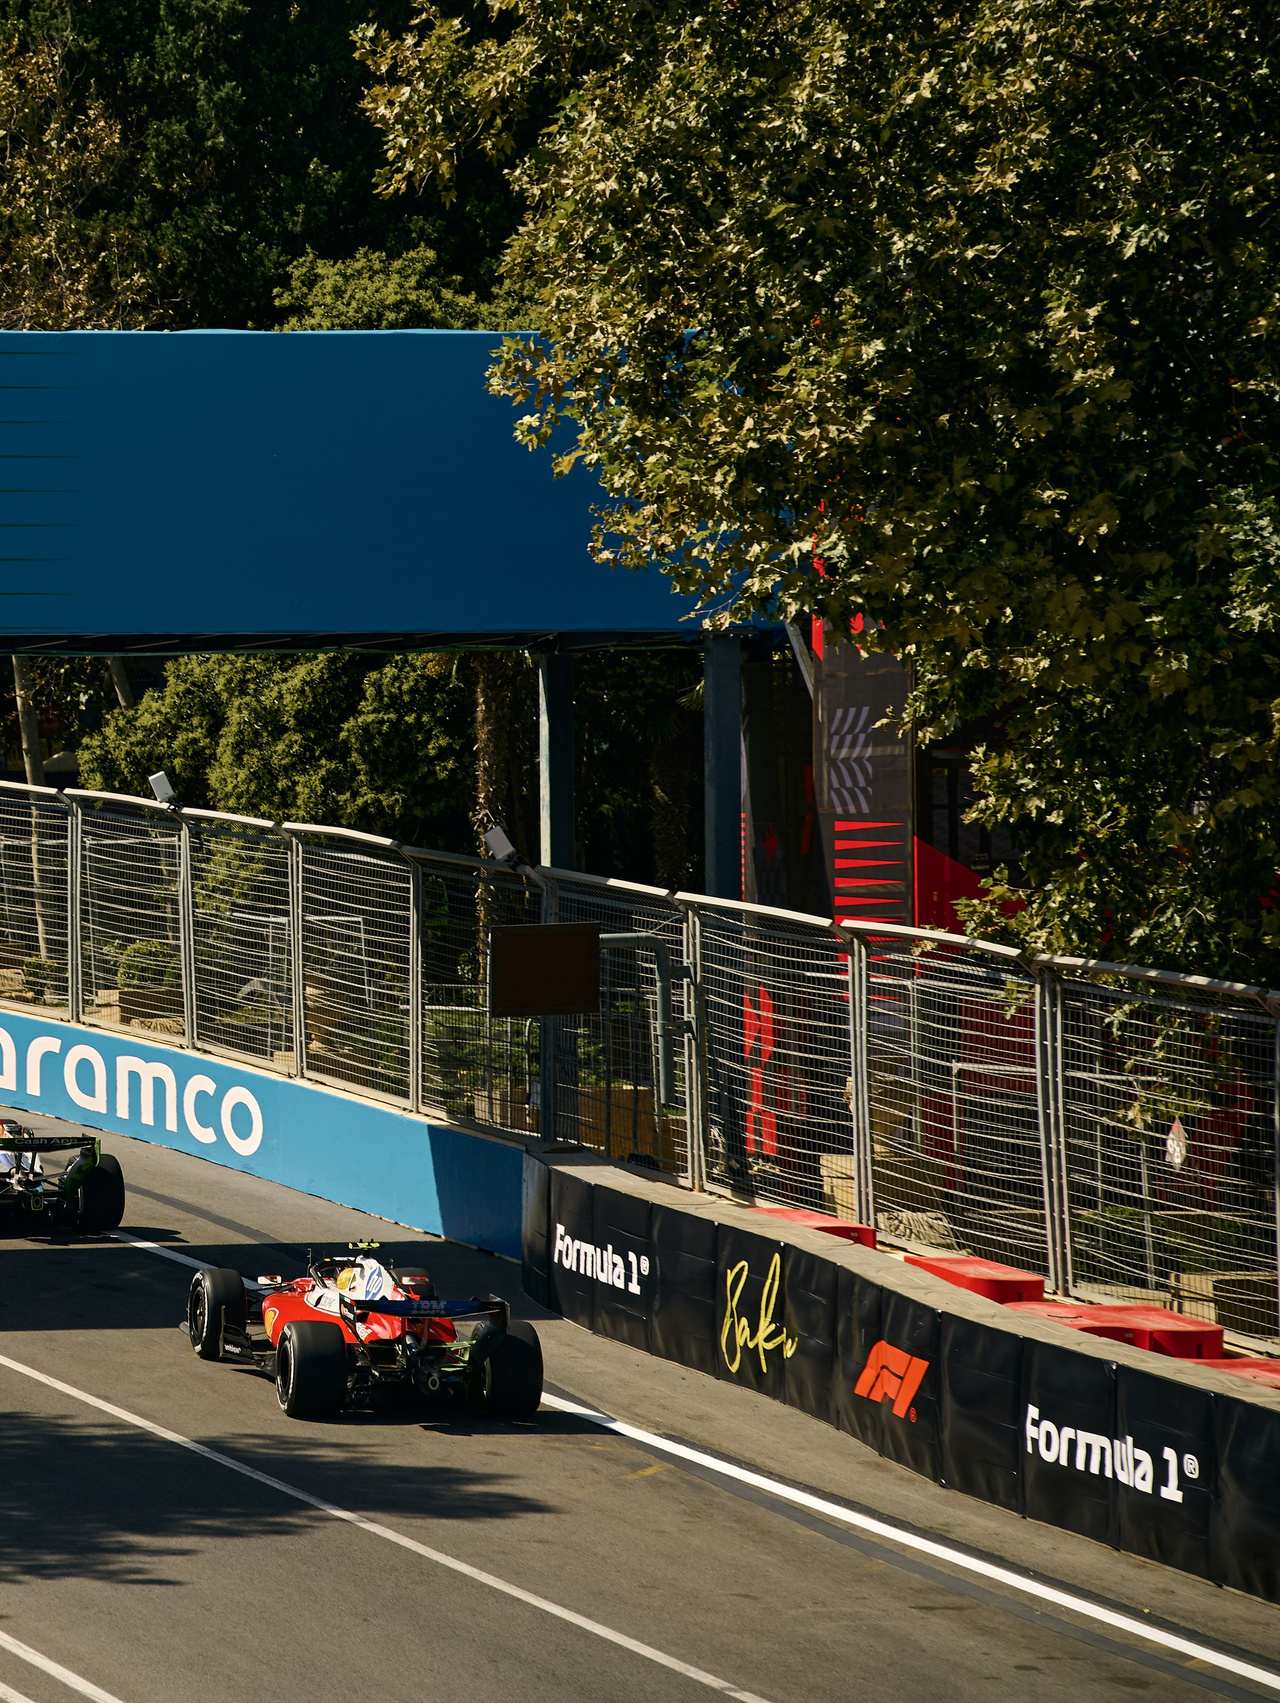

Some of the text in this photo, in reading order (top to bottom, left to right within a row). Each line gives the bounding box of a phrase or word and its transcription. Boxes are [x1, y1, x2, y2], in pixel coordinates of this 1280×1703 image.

[15, 1137, 79, 1146] Cash App
[553, 1222, 625, 1290] Formula
[1025, 1403, 1154, 1495] Formula
